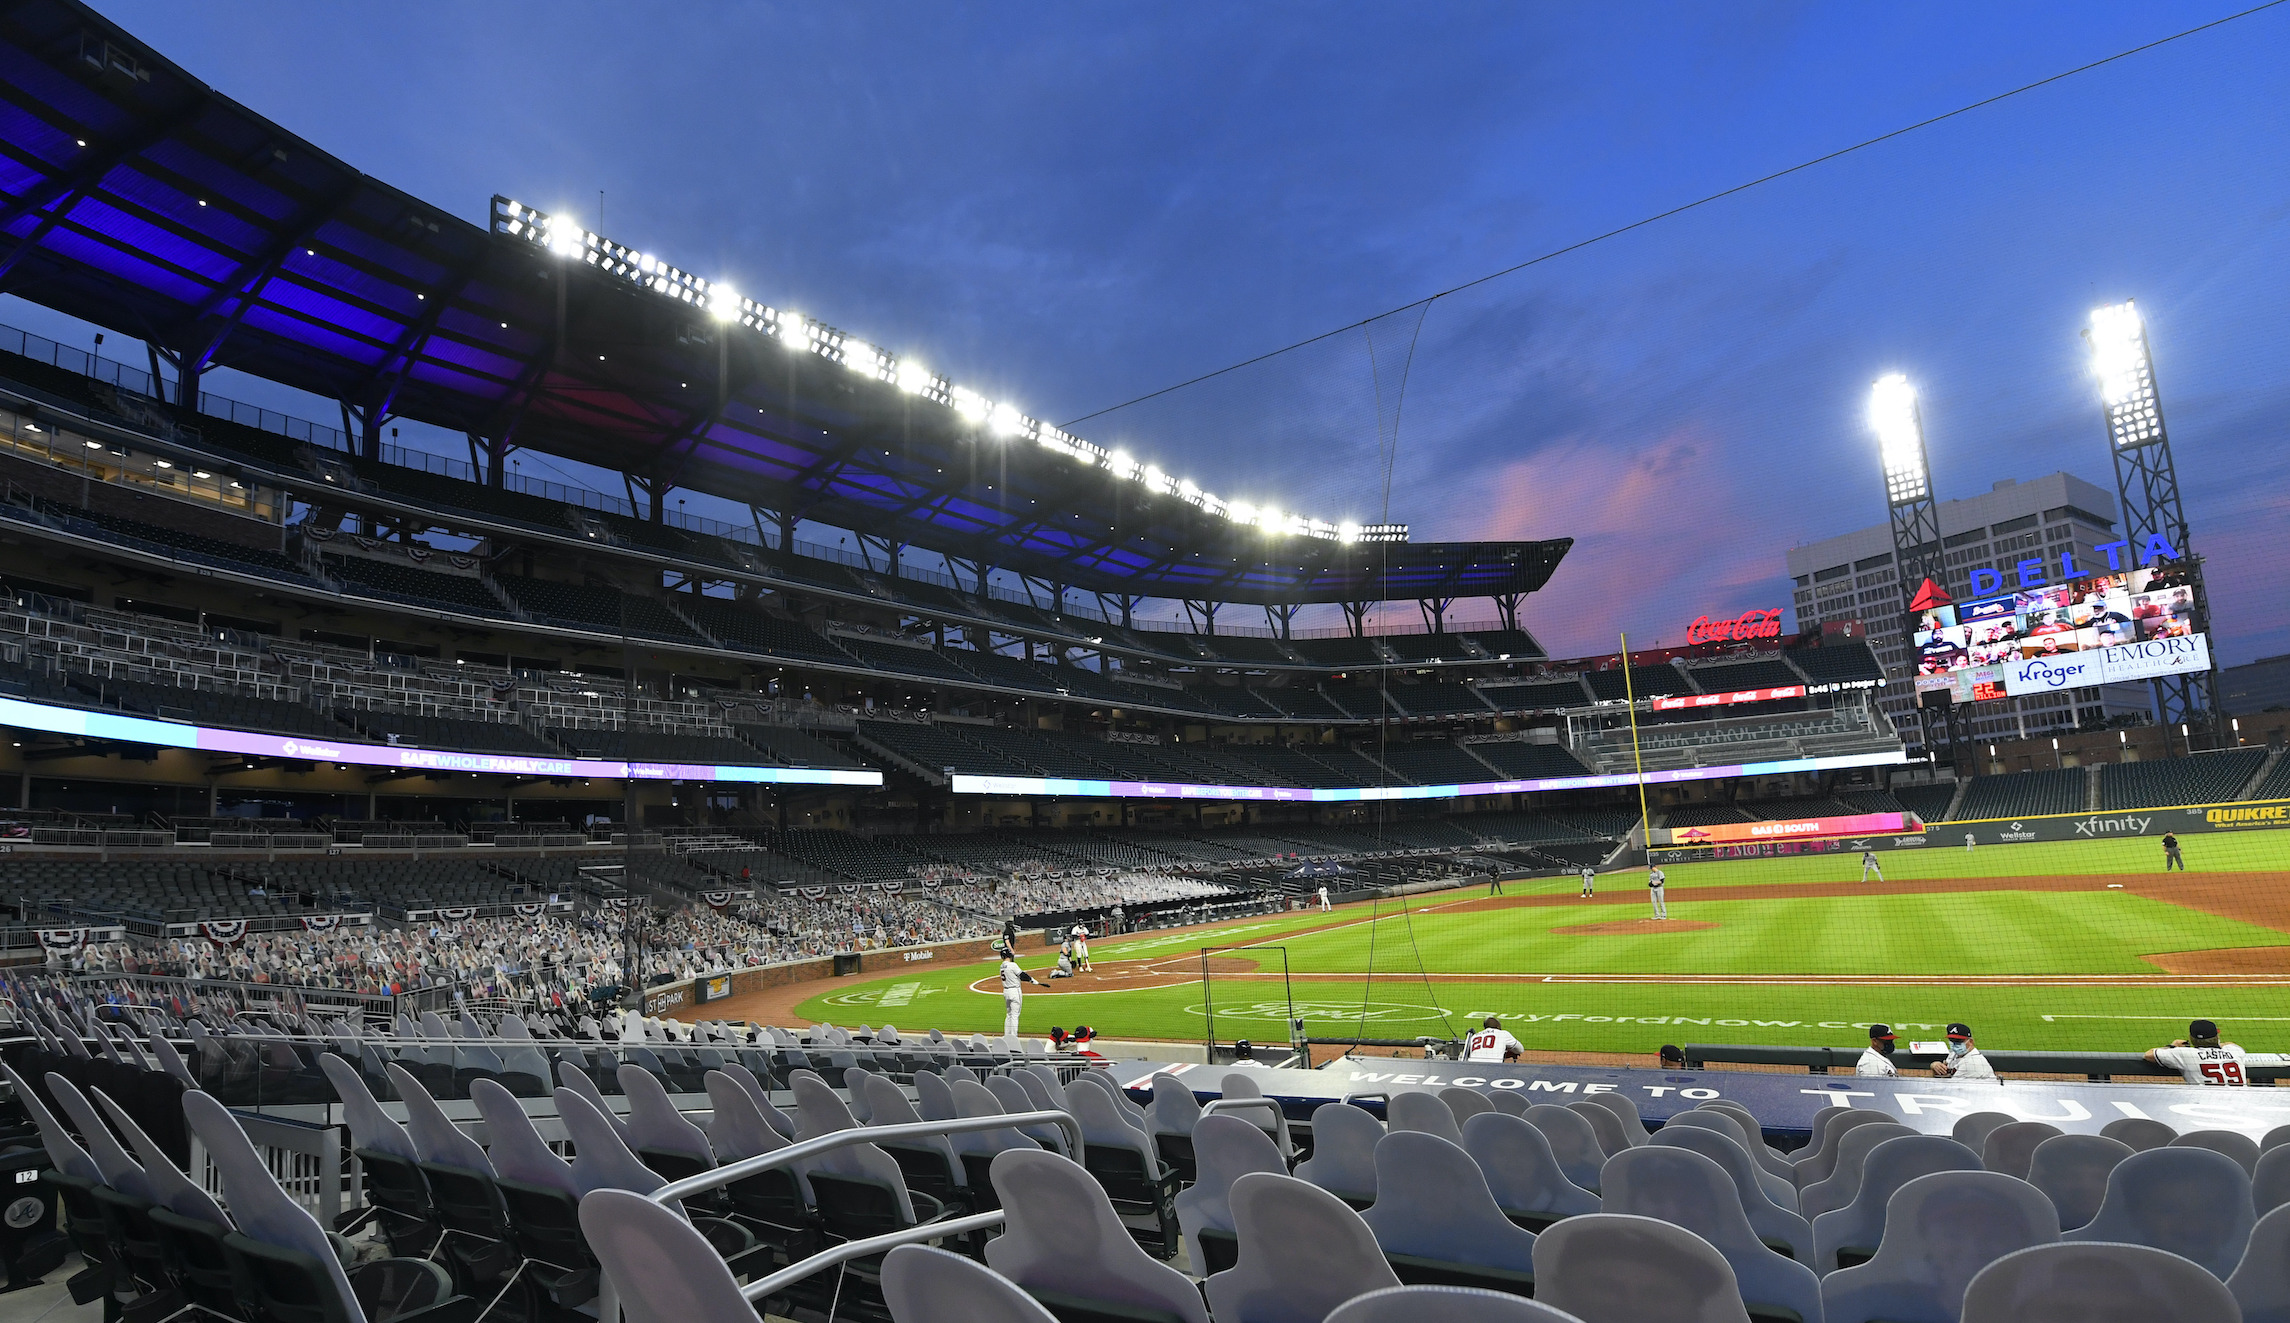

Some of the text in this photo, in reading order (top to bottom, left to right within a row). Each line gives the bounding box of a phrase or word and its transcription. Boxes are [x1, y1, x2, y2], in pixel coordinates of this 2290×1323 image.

[1970, 533, 2179, 596] DELTA
[1687, 608, 1783, 645] Coca-Cola
[2104, 635, 2199, 664] EMORY
[2018, 661, 2085, 687] Kroger
[1974, 682, 1995, 694] 22
[1975, 690, 2007, 700] MILLION
[1555, 708, 1566, 717] 42
[1642, 718, 1851, 748] HANK AARON TERRACE
[299, 745, 573, 773] Wellstar SAFEWHOLEFAMILYCARE
[1751, 823, 1819, 836] GAS SOUTH
[2074, 815, 2151, 837] xfinity
[912, 950, 933, 961] Mobile
[667, 991, 684, 1006] PARK
[1218, 1002, 1401, 1020] Ford
[1463, 1011, 1947, 1031] BuyFordNow.com
[1472, 1035, 1496, 1052] 20
[2197, 1050, 2234, 1061] CASTRO
[2199, 1062, 2243, 1087] 59
[1350, 1071, 1721, 1100] WELCOME TO
[21, 1172, 33, 1182] 12
